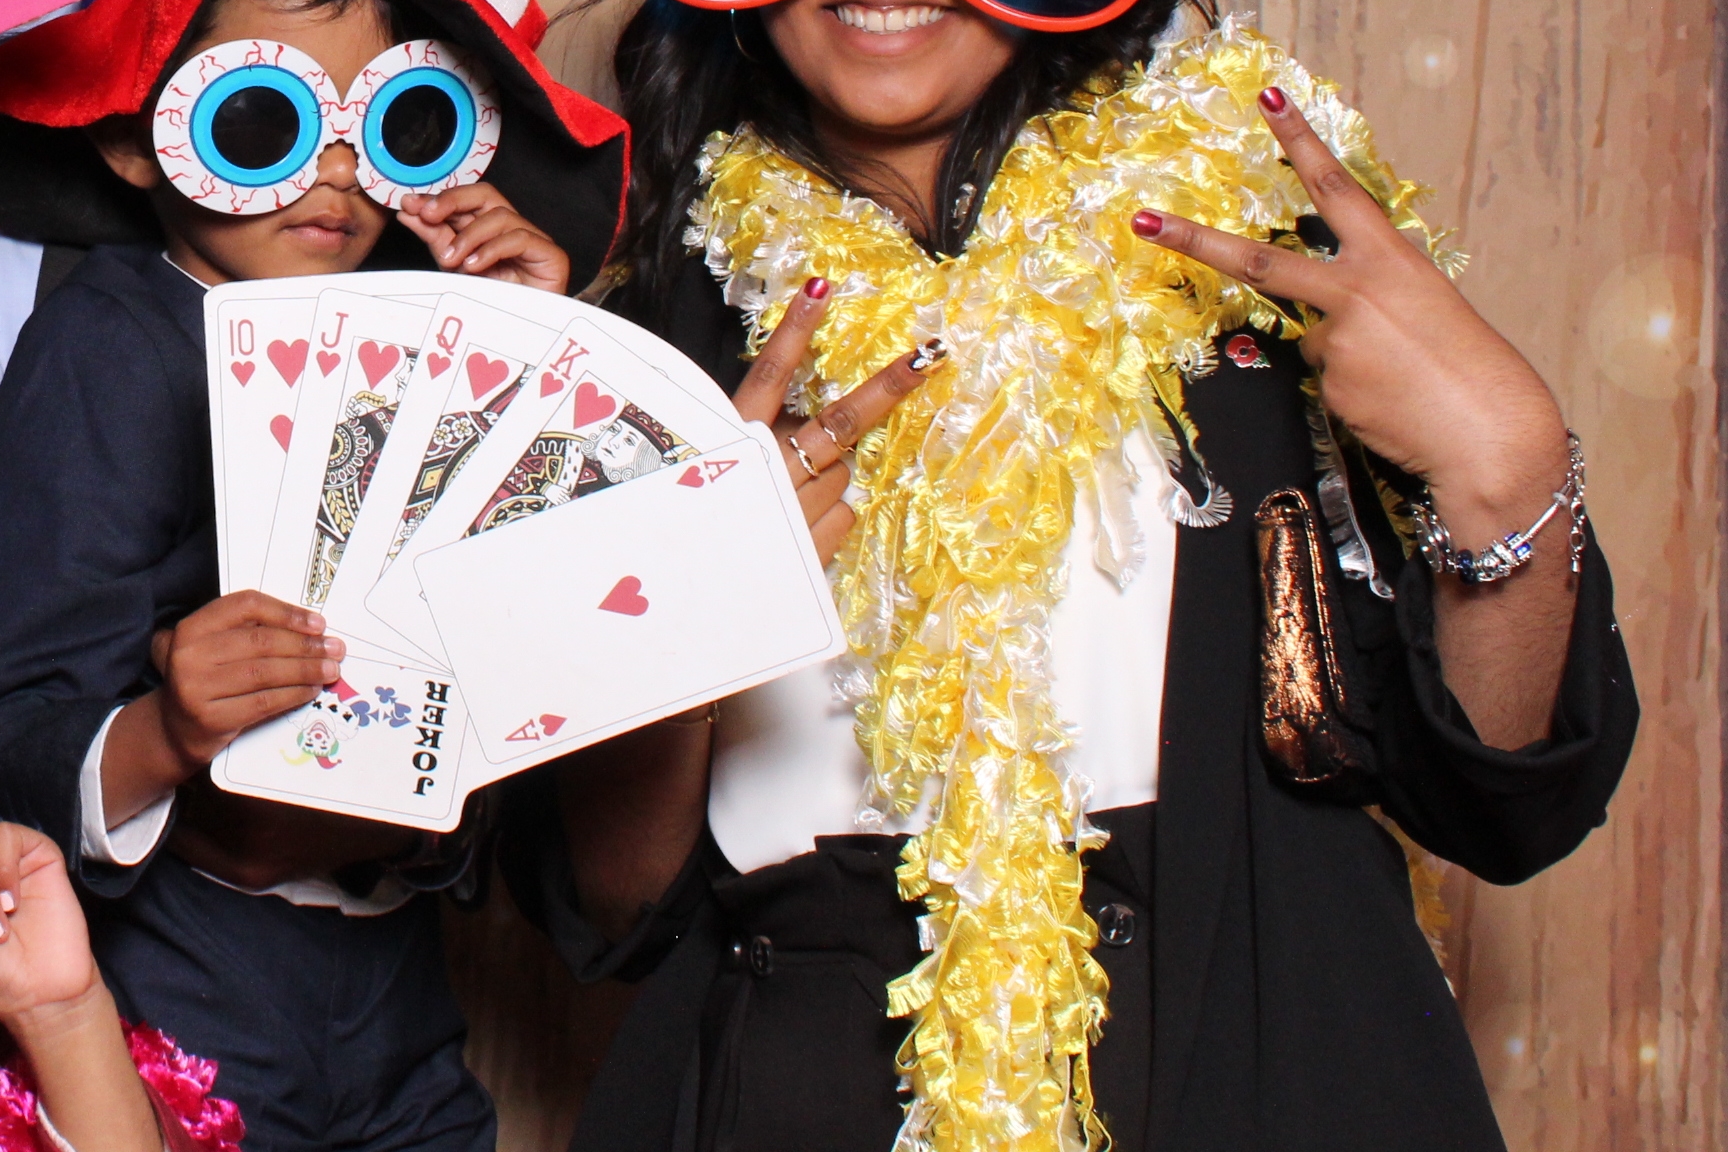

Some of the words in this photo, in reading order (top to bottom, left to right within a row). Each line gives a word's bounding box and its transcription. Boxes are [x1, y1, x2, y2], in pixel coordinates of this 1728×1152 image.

[229, 319, 255, 356] 10
[320, 313, 349, 349] J
[436, 315, 463, 355] Q
[549, 338, 589, 380] K
[704, 459, 740, 482] A
[412, 679, 451, 796] JOKER
[504, 719, 540, 742] A
